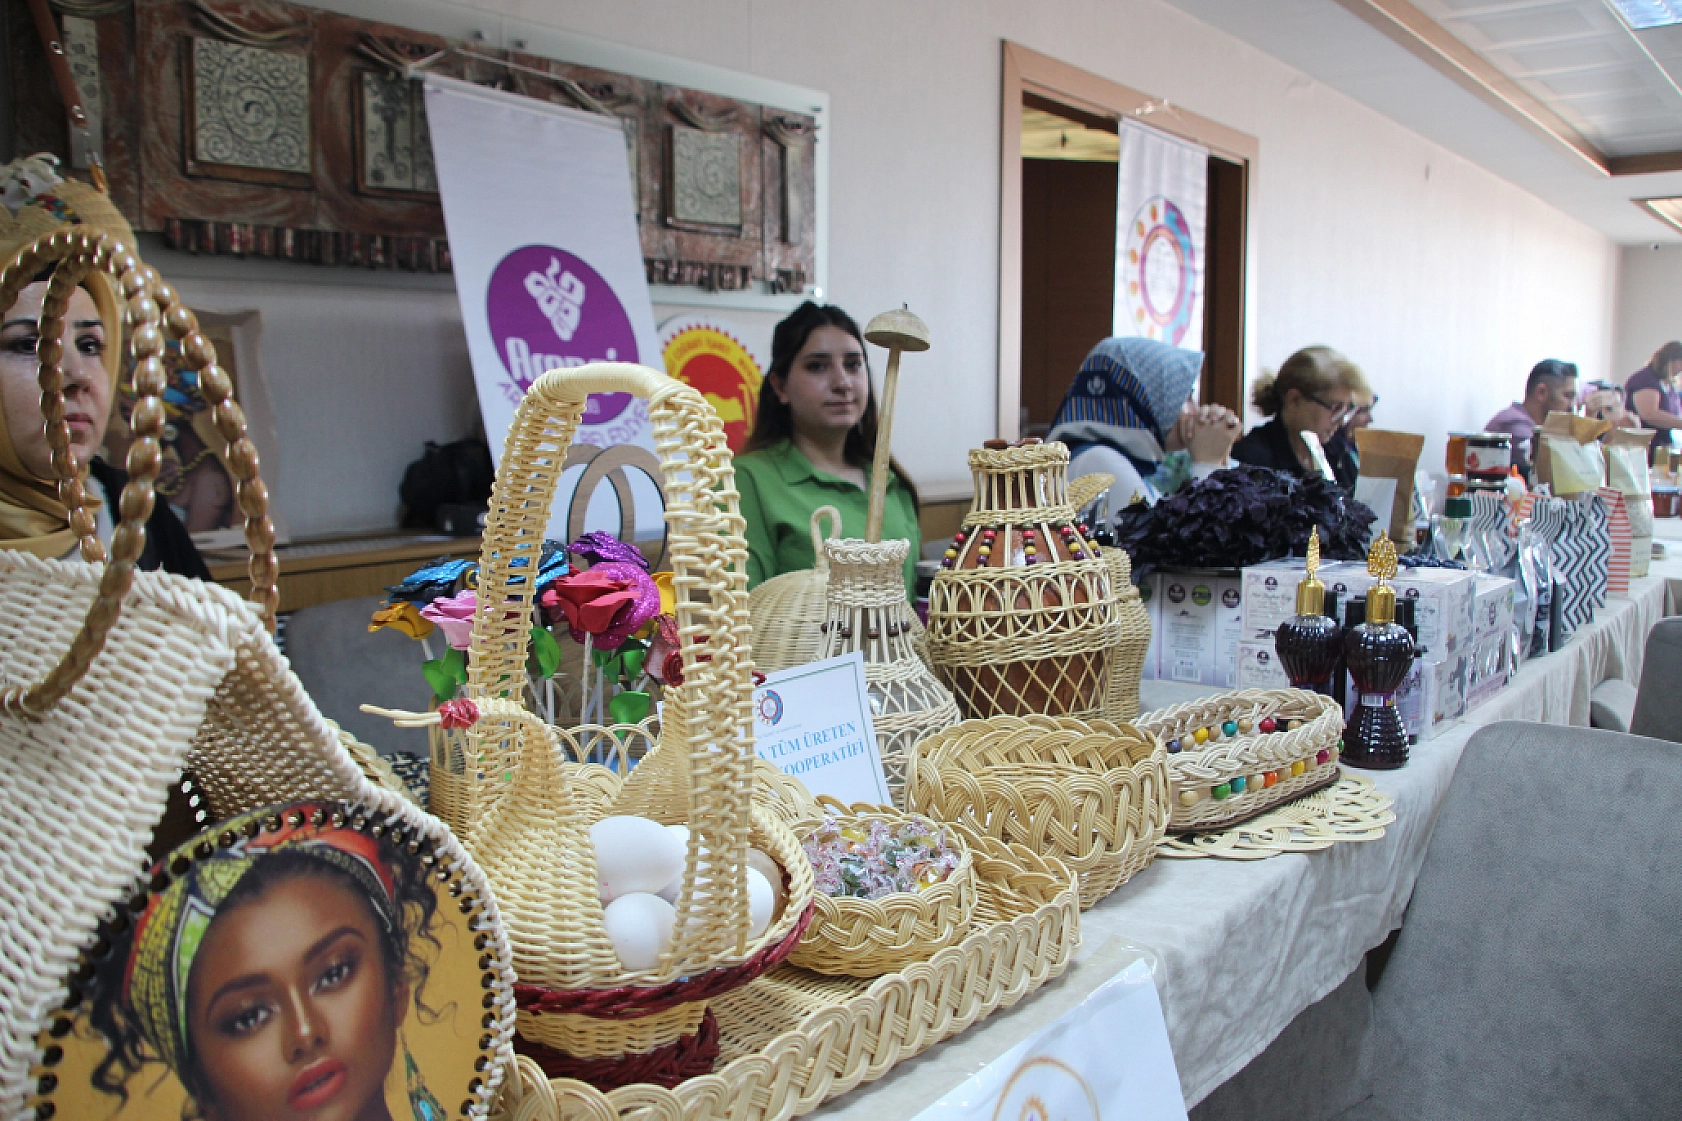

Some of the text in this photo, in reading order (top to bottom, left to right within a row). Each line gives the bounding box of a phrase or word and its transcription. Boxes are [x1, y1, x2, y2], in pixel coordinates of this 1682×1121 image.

[768, 738, 801, 759] TÜM
[803, 721, 855, 748] ÜRETEN
[780, 738, 864, 775] OOPERATİFİ
